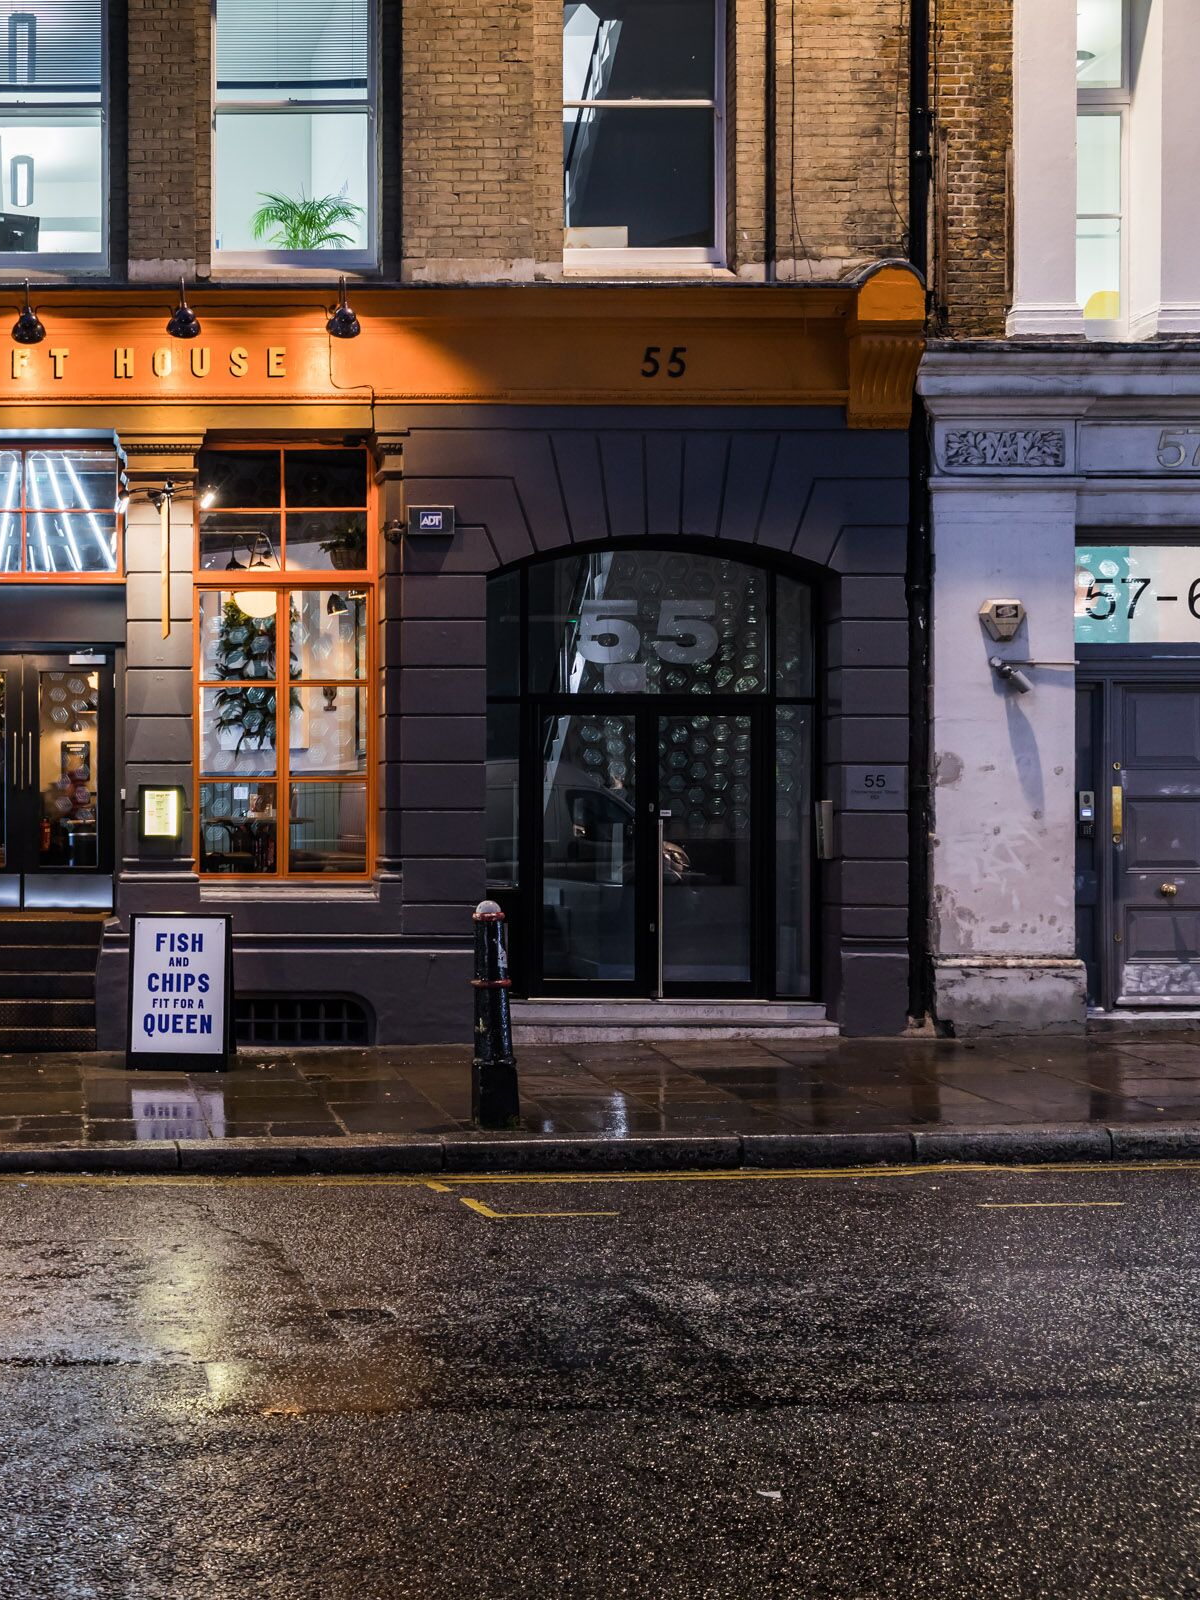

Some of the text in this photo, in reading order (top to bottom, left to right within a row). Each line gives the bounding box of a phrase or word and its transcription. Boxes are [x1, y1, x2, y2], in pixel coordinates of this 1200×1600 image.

[114, 346, 287, 379] HOUSE
[640, 346, 687, 378] 55
[421, 515, 442, 526] ADT
[576, 600, 719, 664] 55
[864, 774, 886, 788] 55
[155, 933, 203, 952] FISH
[168, 957, 189, 967] AND
[147, 973, 210, 993] CHIPS
[152, 998, 204, 1009] FIT FOR A
[143, 1013, 212, 1037] QUEEN
